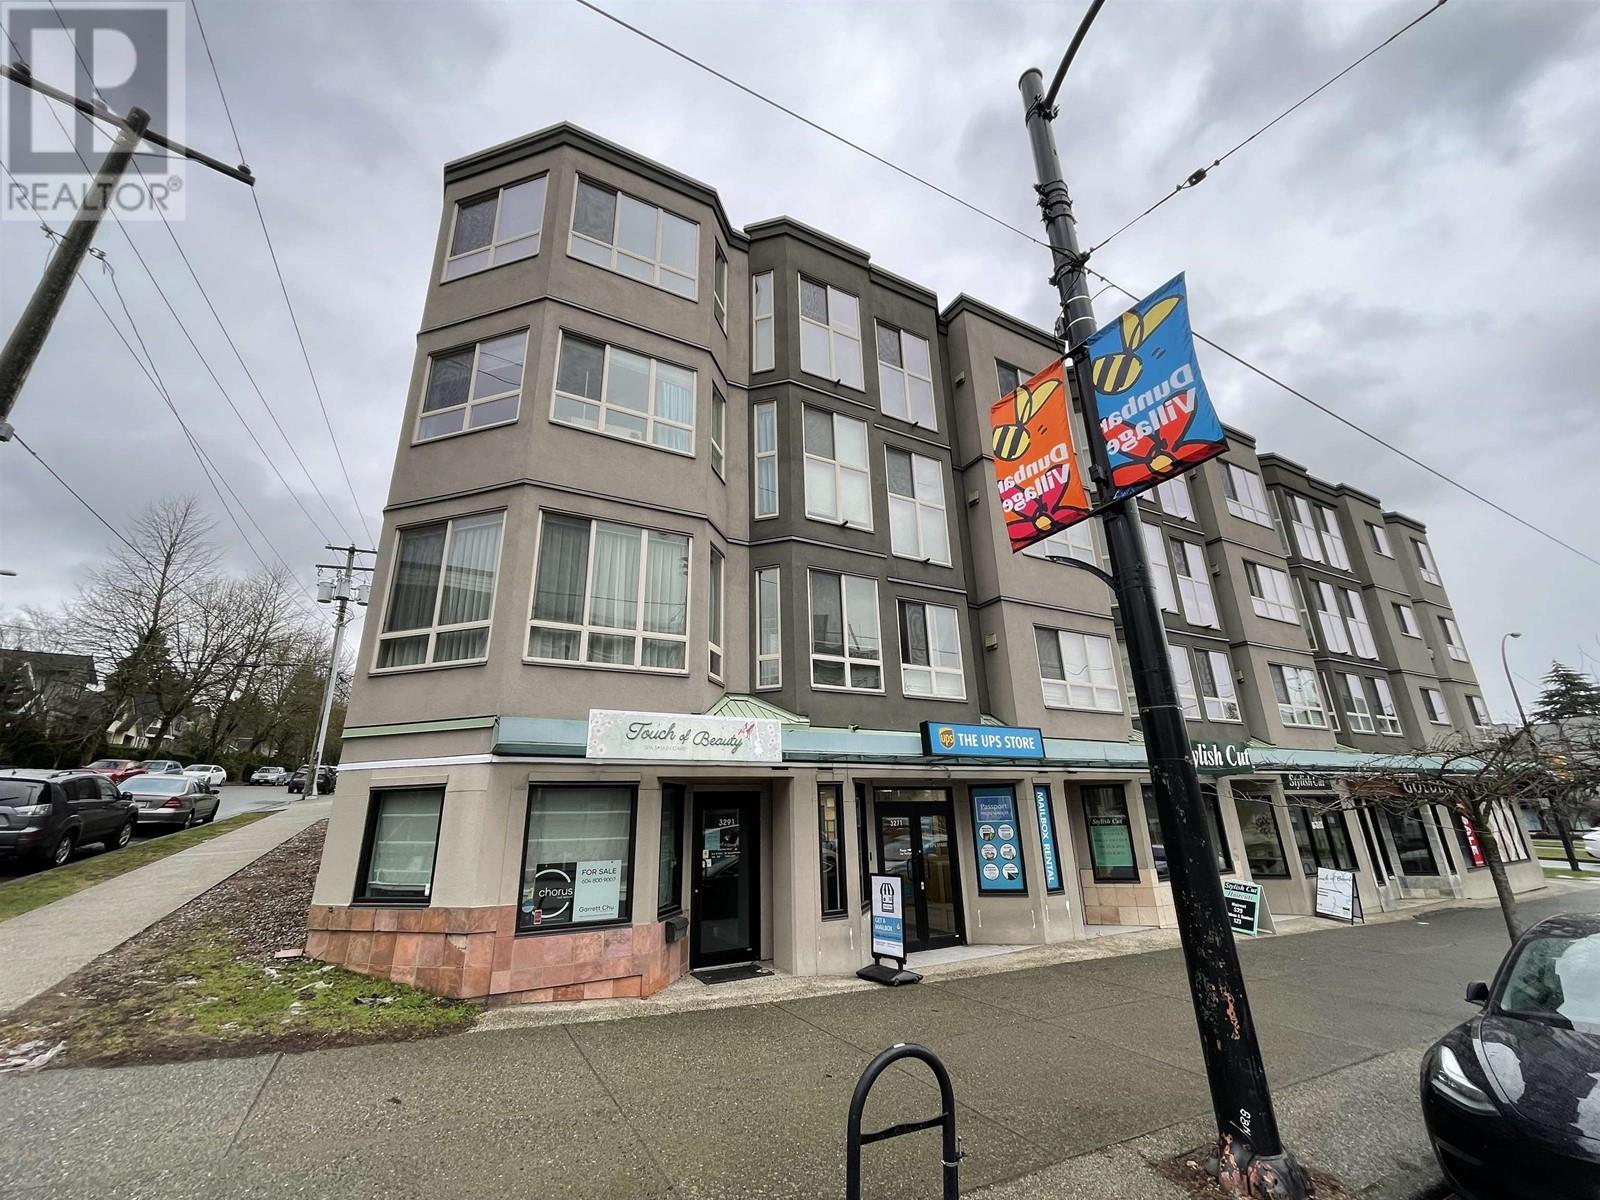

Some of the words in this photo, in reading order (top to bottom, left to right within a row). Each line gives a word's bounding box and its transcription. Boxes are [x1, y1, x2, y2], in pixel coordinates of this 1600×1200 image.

[626, 721, 676, 741] Touch
[679, 729, 692, 745] of
[692, 730, 743, 754] Beauty
[958, 733, 979, 747] THE
[981, 734, 1002, 749] UPS
[1004, 735, 1035, 750] STORE
[1192, 743, 1223, 768] ylish
[1226, 744, 1250, 767] Cut
[1288, 774, 1312, 789] Stylish
[718, 818, 735, 826] 3291
[890, 819, 903, 827] 3271
[1036, 791, 1049, 839] MAILBOX
[1043, 843, 1055, 883] RENTAL
[598, 867, 617, 875] SALE
[538, 887, 573, 898] chorus
[578, 905, 601, 913] Garrett
